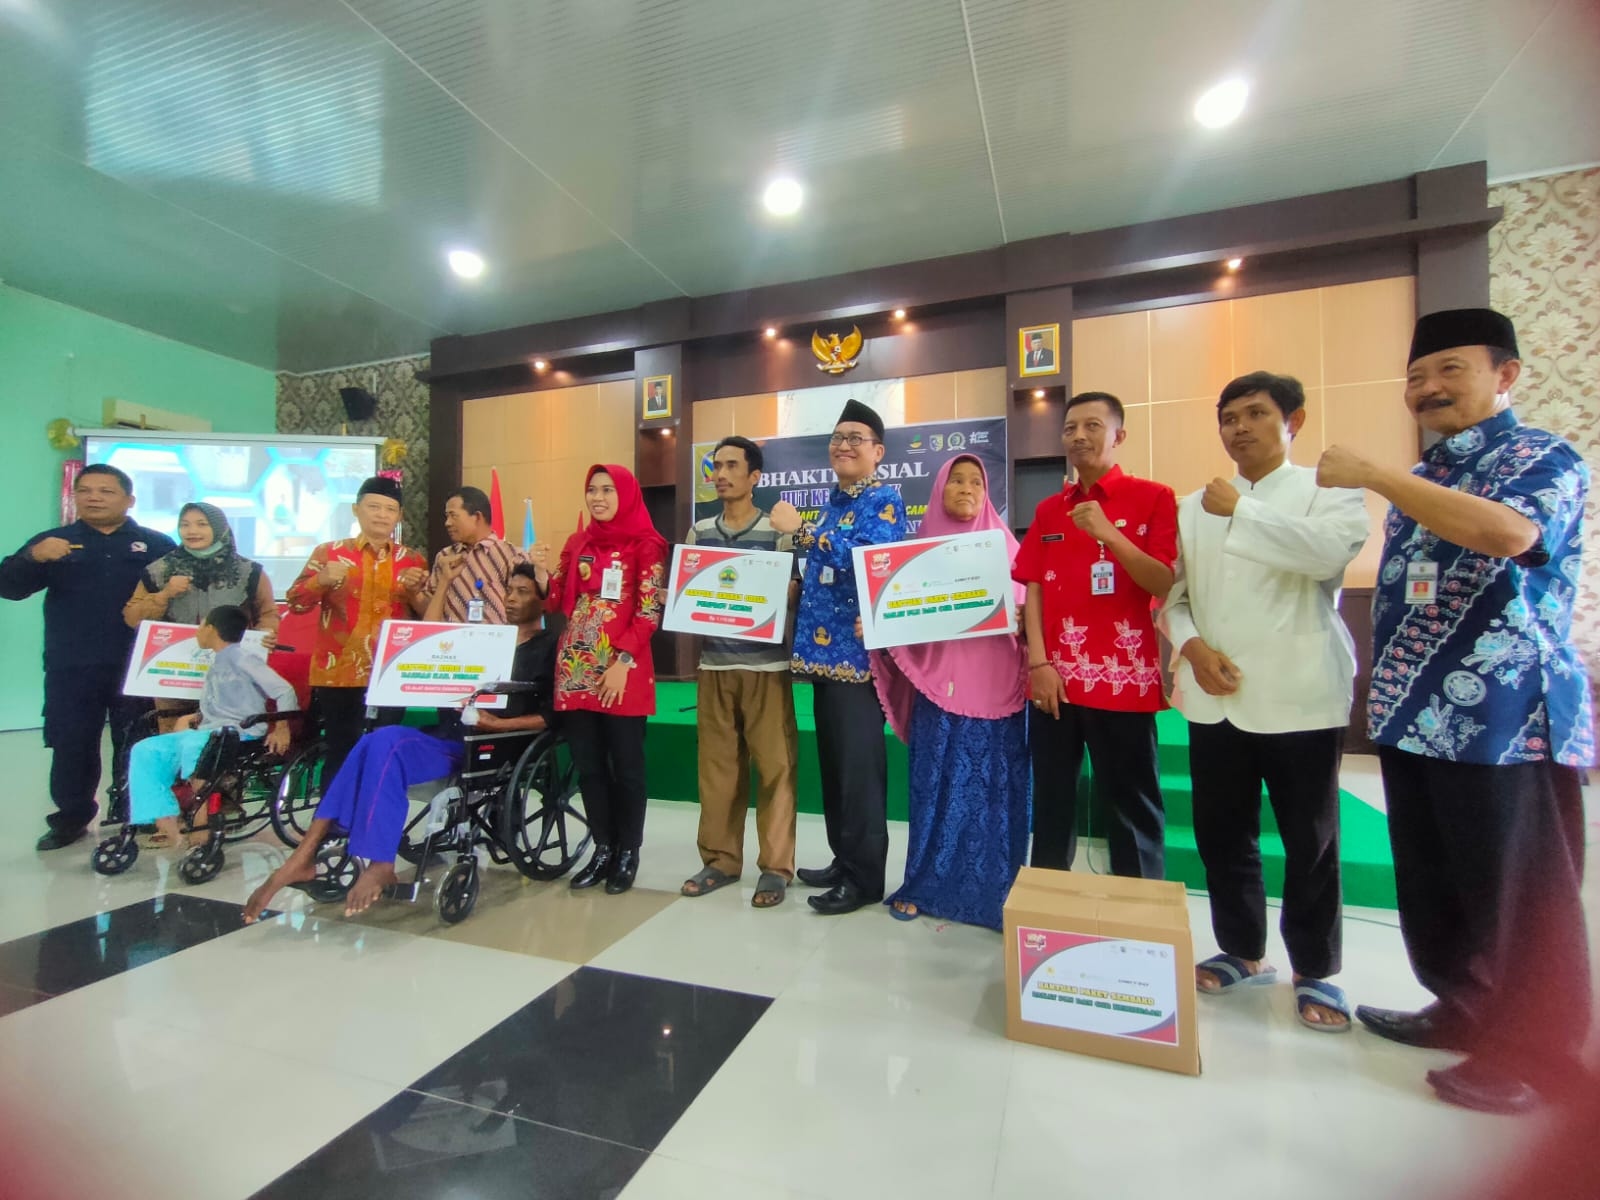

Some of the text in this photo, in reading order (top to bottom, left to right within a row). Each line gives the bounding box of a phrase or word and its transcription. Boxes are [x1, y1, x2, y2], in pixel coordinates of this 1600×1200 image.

[874, 461, 931, 480] SIAL
[780, 489, 809, 508] HUT
[798, 510, 820, 520] ANT
[1037, 981, 1079, 995] BANTUAN
[1079, 987, 1109, 999] PAKET
[1110, 991, 1155, 1006] SEMBAKO
